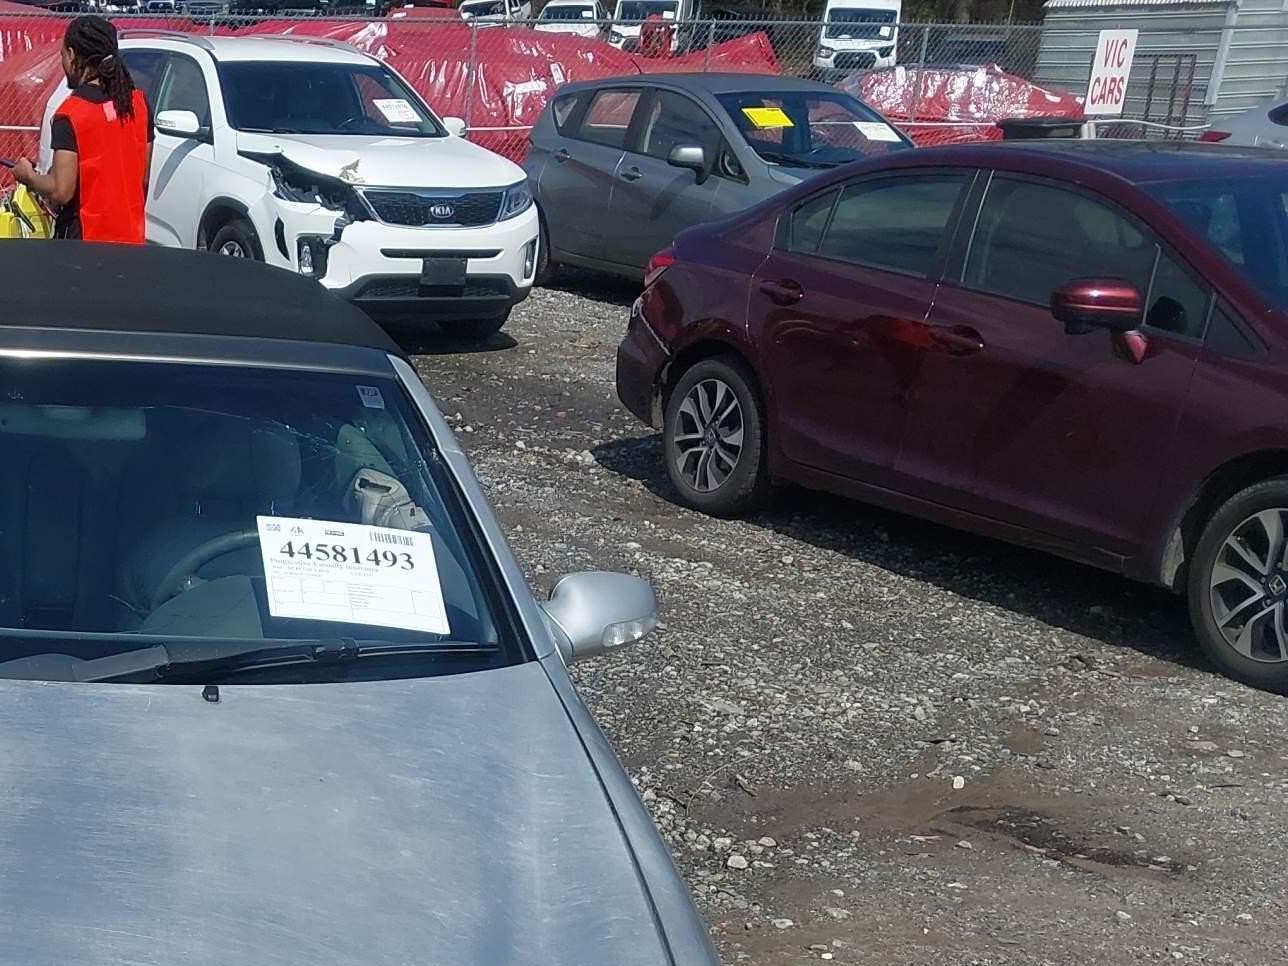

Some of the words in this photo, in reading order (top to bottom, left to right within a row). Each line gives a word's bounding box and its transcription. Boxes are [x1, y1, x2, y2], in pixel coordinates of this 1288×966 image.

[1103, 38, 1128, 68] VIC
[1090, 76, 1125, 105] CARS
[435, 205, 451, 216] KIA
[280, 540, 414, 571] 44581493
